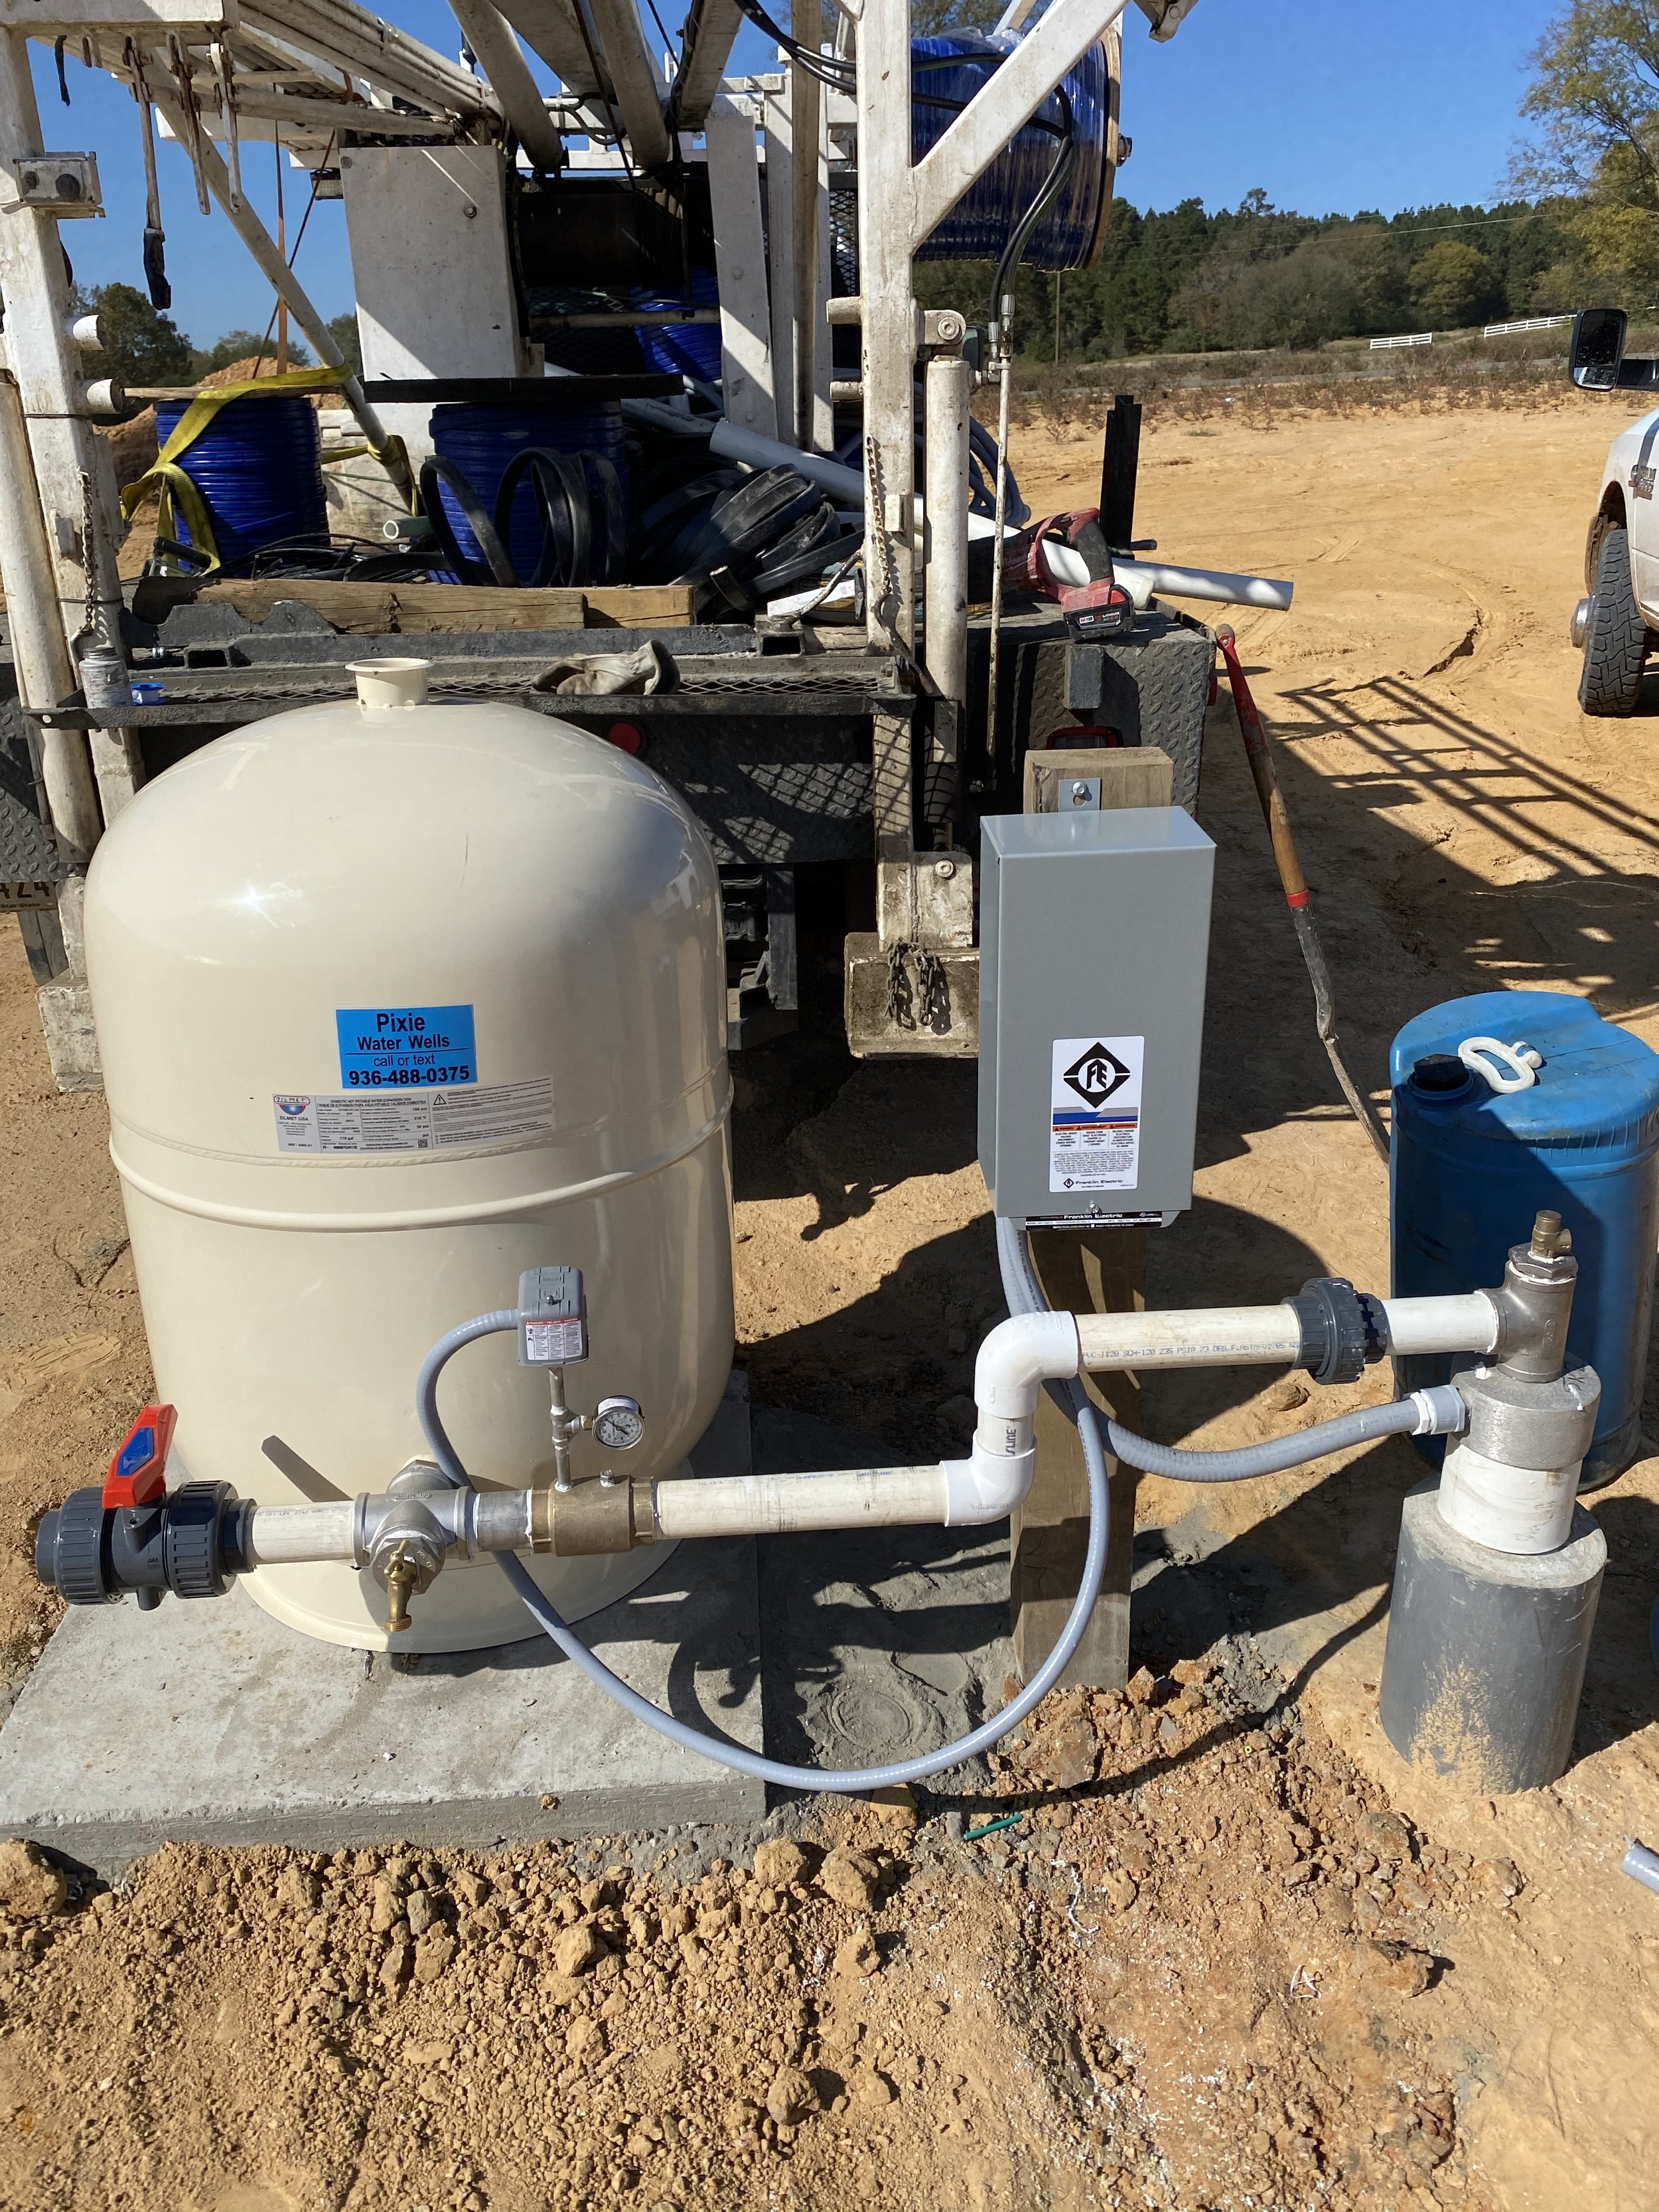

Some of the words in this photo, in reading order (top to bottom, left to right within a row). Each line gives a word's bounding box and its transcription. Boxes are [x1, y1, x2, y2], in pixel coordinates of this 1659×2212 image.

[376, 1012, 426, 1033] Pixie
[356, 1036, 402, 1051] Water
[407, 1033, 450, 1049] Wells
[374, 1055, 394, 1067] call
[397, 1057, 410, 1067] or
[413, 1053, 435, 1066] text
[348, 1065, 470, 1086] 936-488-0375
